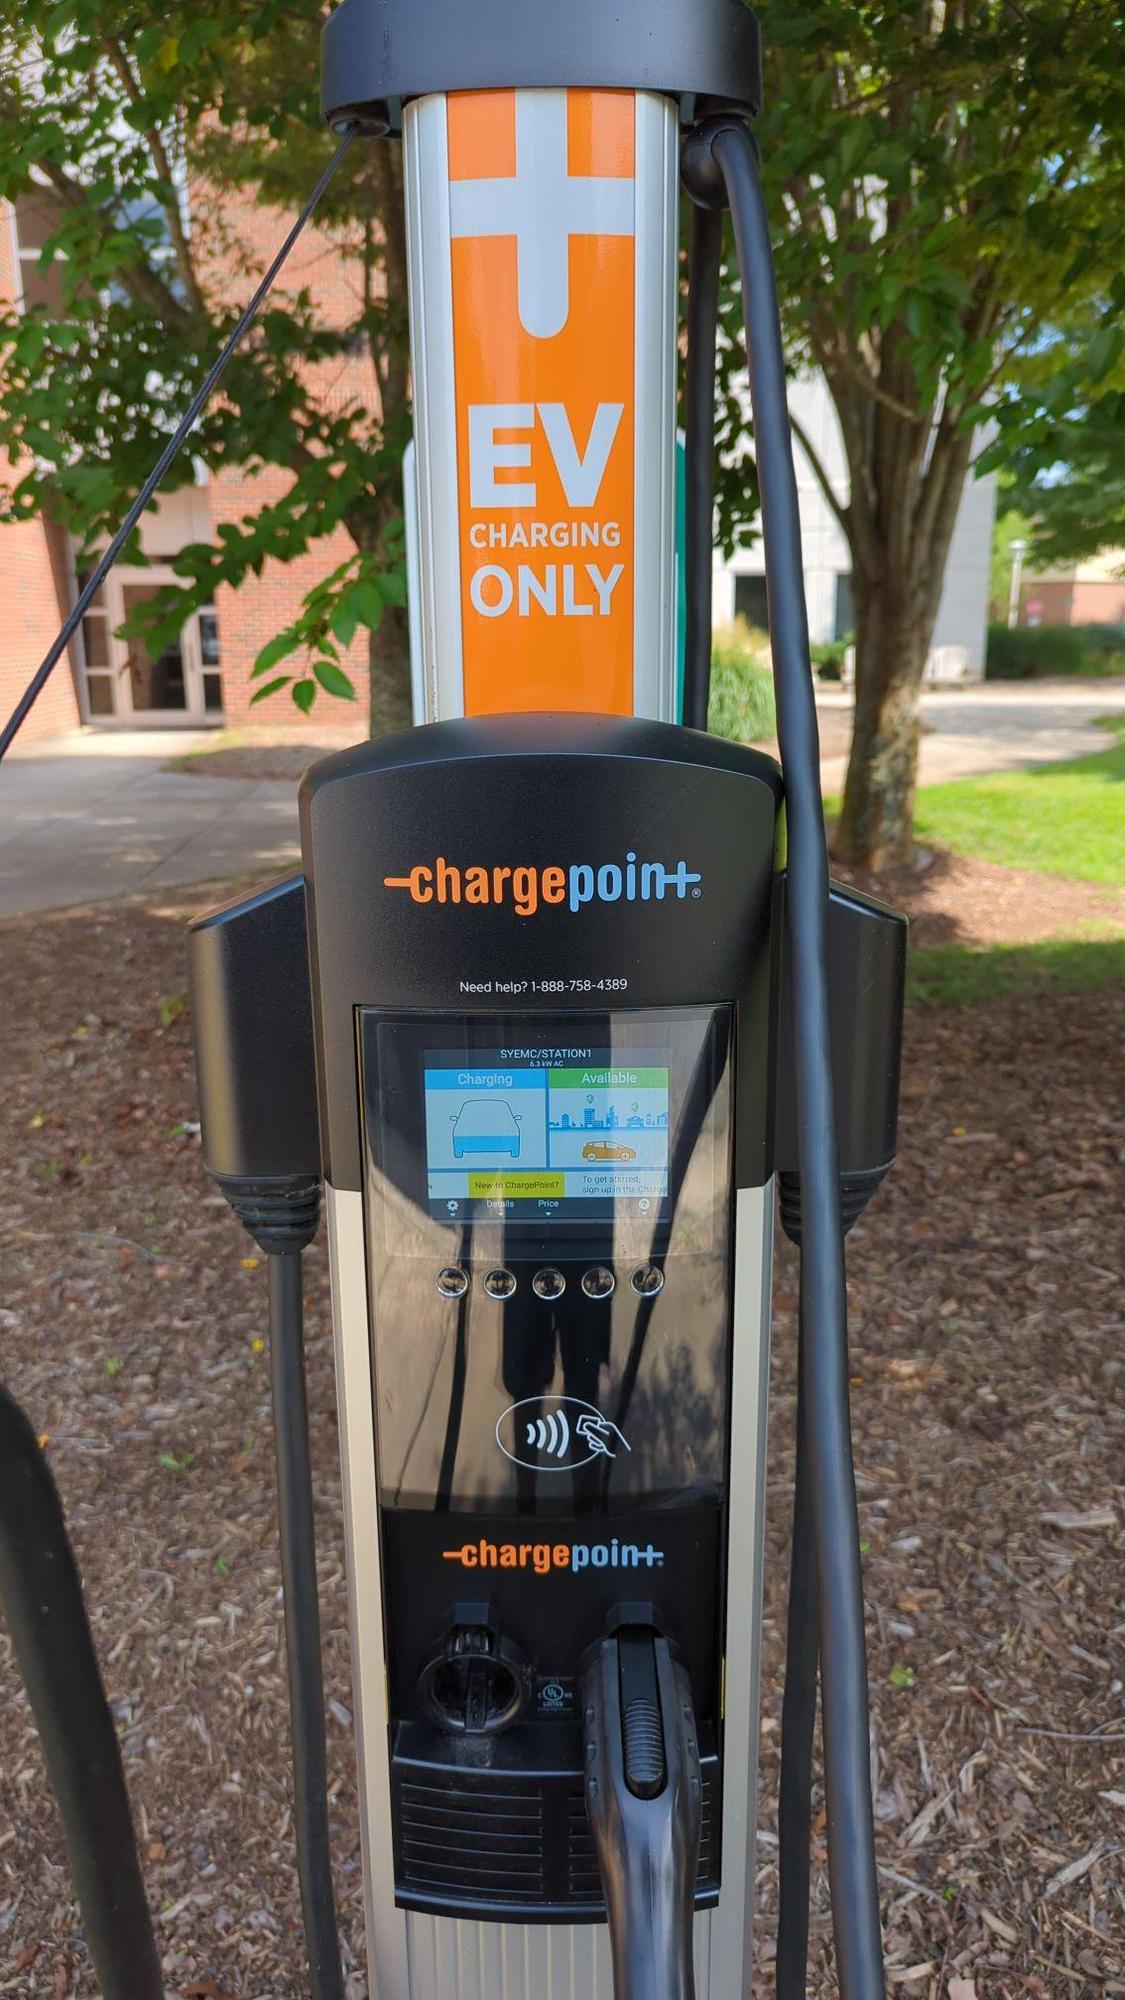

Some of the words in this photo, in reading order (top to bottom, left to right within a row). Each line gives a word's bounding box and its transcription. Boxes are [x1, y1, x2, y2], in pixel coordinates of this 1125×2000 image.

[468, 402, 625, 508] EV
[469, 522, 621, 548] CHARGING
[470, 564, 625, 618] ONLY
[459, 981, 491, 993] Need
[495, 981, 527, 995] help?
[531, 978, 628, 993] 1-888-758-4389
[500, 1049, 592, 1059] SYEMC/STATION1
[458, 1073, 513, 1087] Charging
[581, 1072, 637, 1084] Available
[505, 1181, 560, 1190] ChargePoint?
[594, 1176, 607, 1185] get
[582, 1186, 599, 1194] sign
[486, 1200, 515, 1208] Details
[538, 1200, 559, 1208] Price
